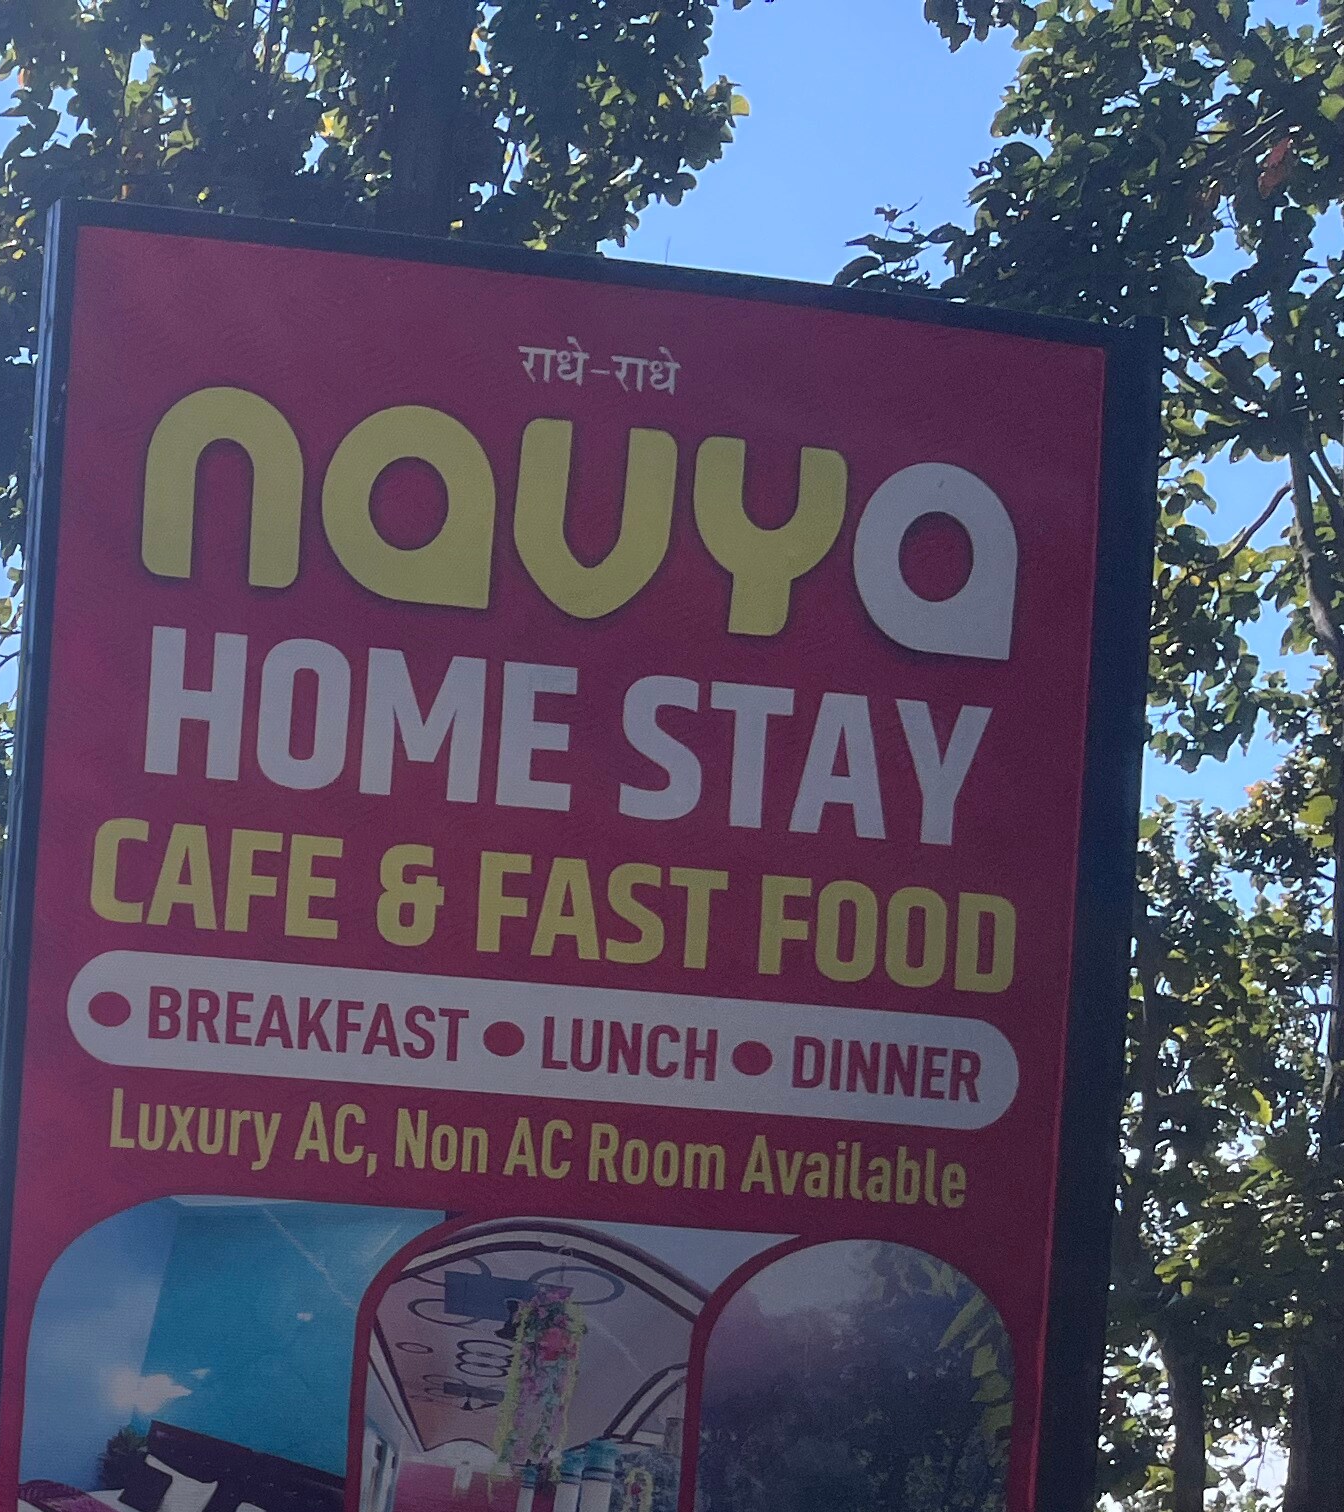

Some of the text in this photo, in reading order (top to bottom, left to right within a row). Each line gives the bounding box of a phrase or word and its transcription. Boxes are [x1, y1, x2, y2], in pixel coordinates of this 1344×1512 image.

[518, 336, 681, 395] राधे-राधे
[143, 626, 993, 845] HOME STAY
[90, 817, 1017, 994] CAFE & FAST FOOD
[147, 985, 981, 1102] BREAKFAST LUNCH DINNER
[109, 1087, 967, 1209] Luxury AC, Non AC Room Available
